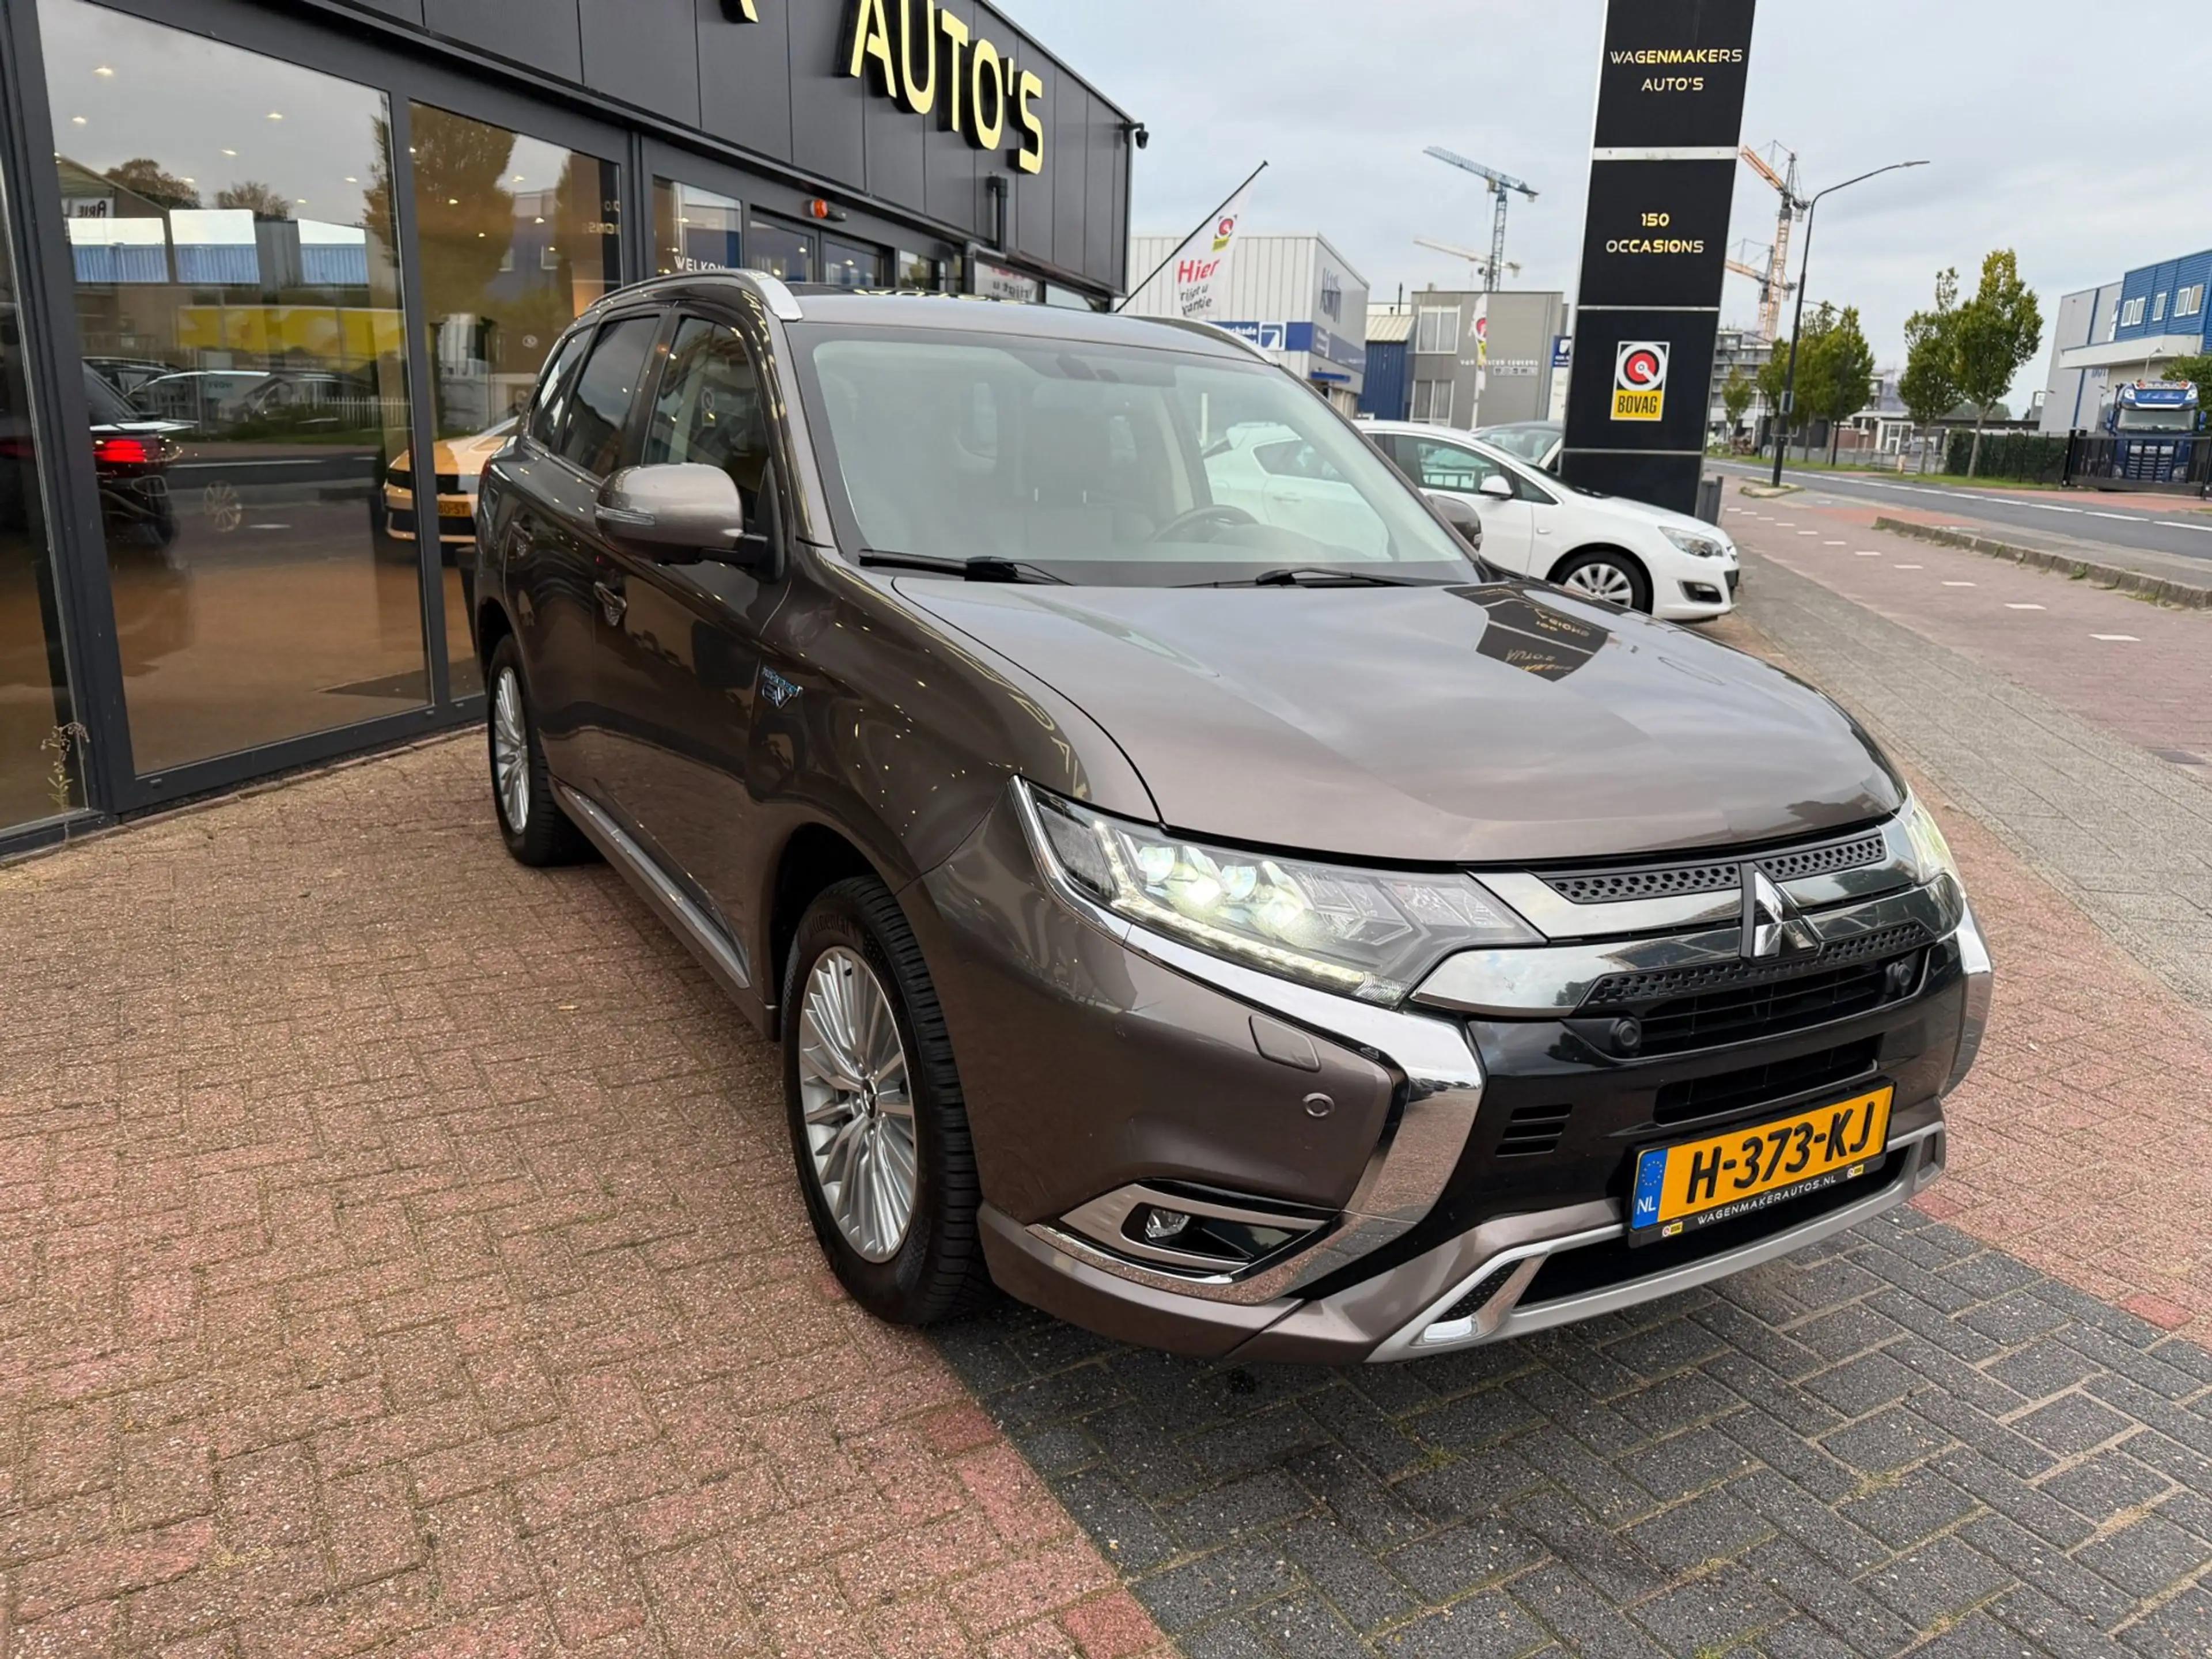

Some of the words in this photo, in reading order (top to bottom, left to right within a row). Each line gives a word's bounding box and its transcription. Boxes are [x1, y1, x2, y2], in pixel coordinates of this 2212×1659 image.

[1610, 49, 1743, 64] WAGENMAKERS
[850, 0, 1043, 175] AUTO'S
[1641, 77, 1705, 92] AUTO'S
[1641, 213, 1670, 227] 150
[1605, 239, 1705, 253] OCCASIONS
[1178, 259, 1221, 284] Hier
[1617, 395, 1658, 414] BOVAG
[1686, 1101, 1876, 1204] H-373-KJ
[1637, 1195, 1657, 1215] NL
[1697, 1175, 1836, 1225] WAGENMAKERAUTOS.NL
